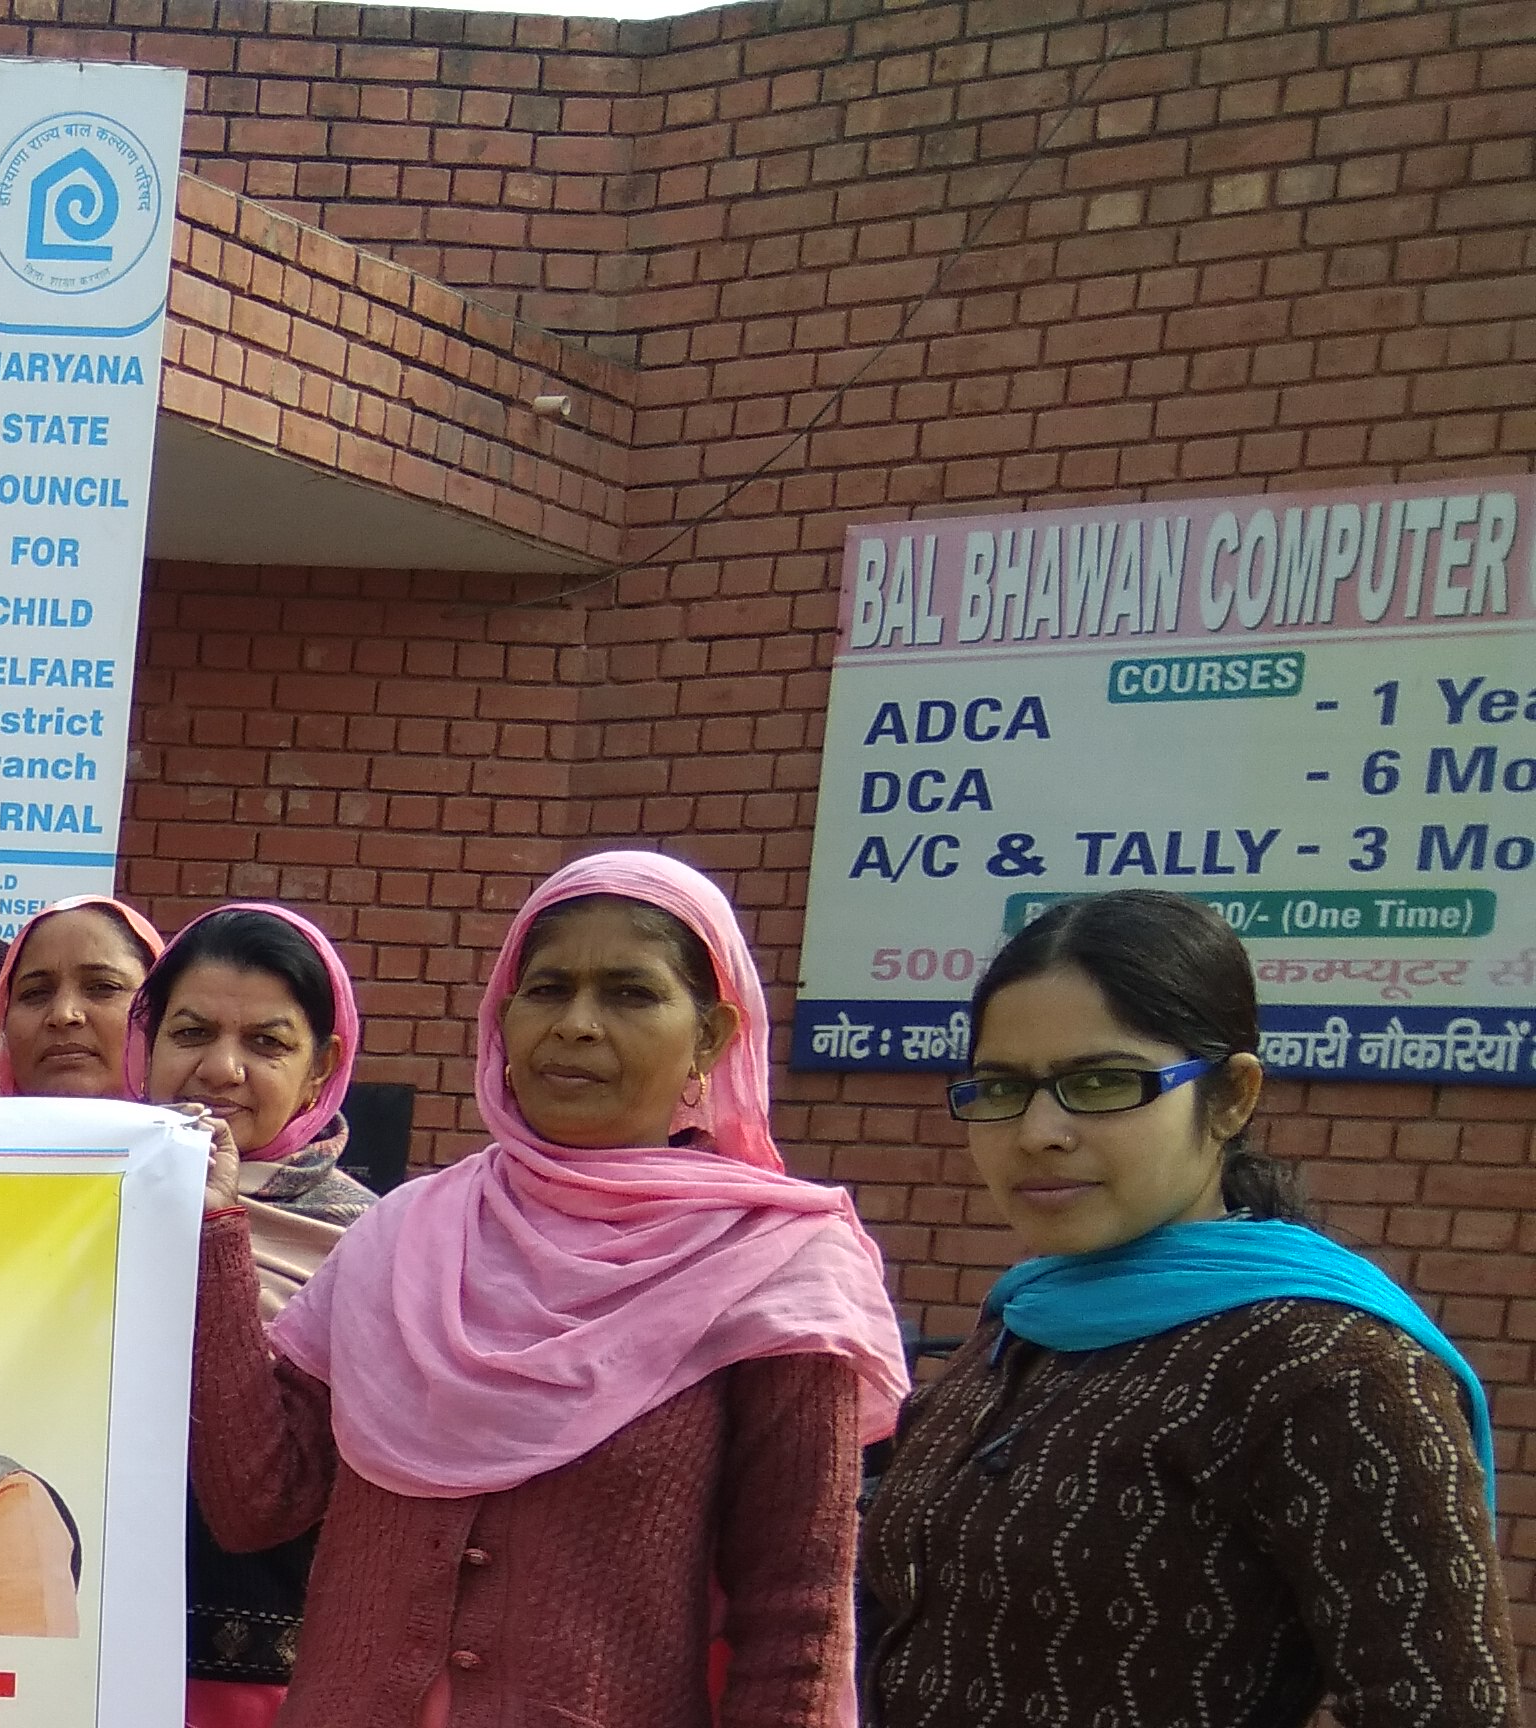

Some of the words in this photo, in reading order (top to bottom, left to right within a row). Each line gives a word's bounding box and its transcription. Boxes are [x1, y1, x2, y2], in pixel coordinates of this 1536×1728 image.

[28, 126, 61, 150] राज्य
[64, 123, 92, 138] बाल
[96, 126, 138, 166] कल्याण
[2, 413, 109, 446] STATE
[10, 536, 80, 567] FOR
[851, 534, 944, 649] BAL
[958, 516, 1192, 644] BHAWAN
[1200, 491, 1519, 632] COMPUTER
[1116, 657, 1298, 696] COURSES
[863, 695, 1051, 746] ADCA
[1374, 680, 1399, 725] 1
[859, 768, 993, 815] DCA
[1362, 749, 1401, 796] 6
[848, 834, 961, 884] A/C
[986, 833, 1048, 878] &
[1075, 828, 1282, 877] TALLY
[1348, 825, 1389, 872] 3
[1282, 900, 1361, 934] (One
[1374, 898, 1473, 934] Time)
[871, 948, 975, 982] 500
[811, 1011, 874, 1059] नोट
